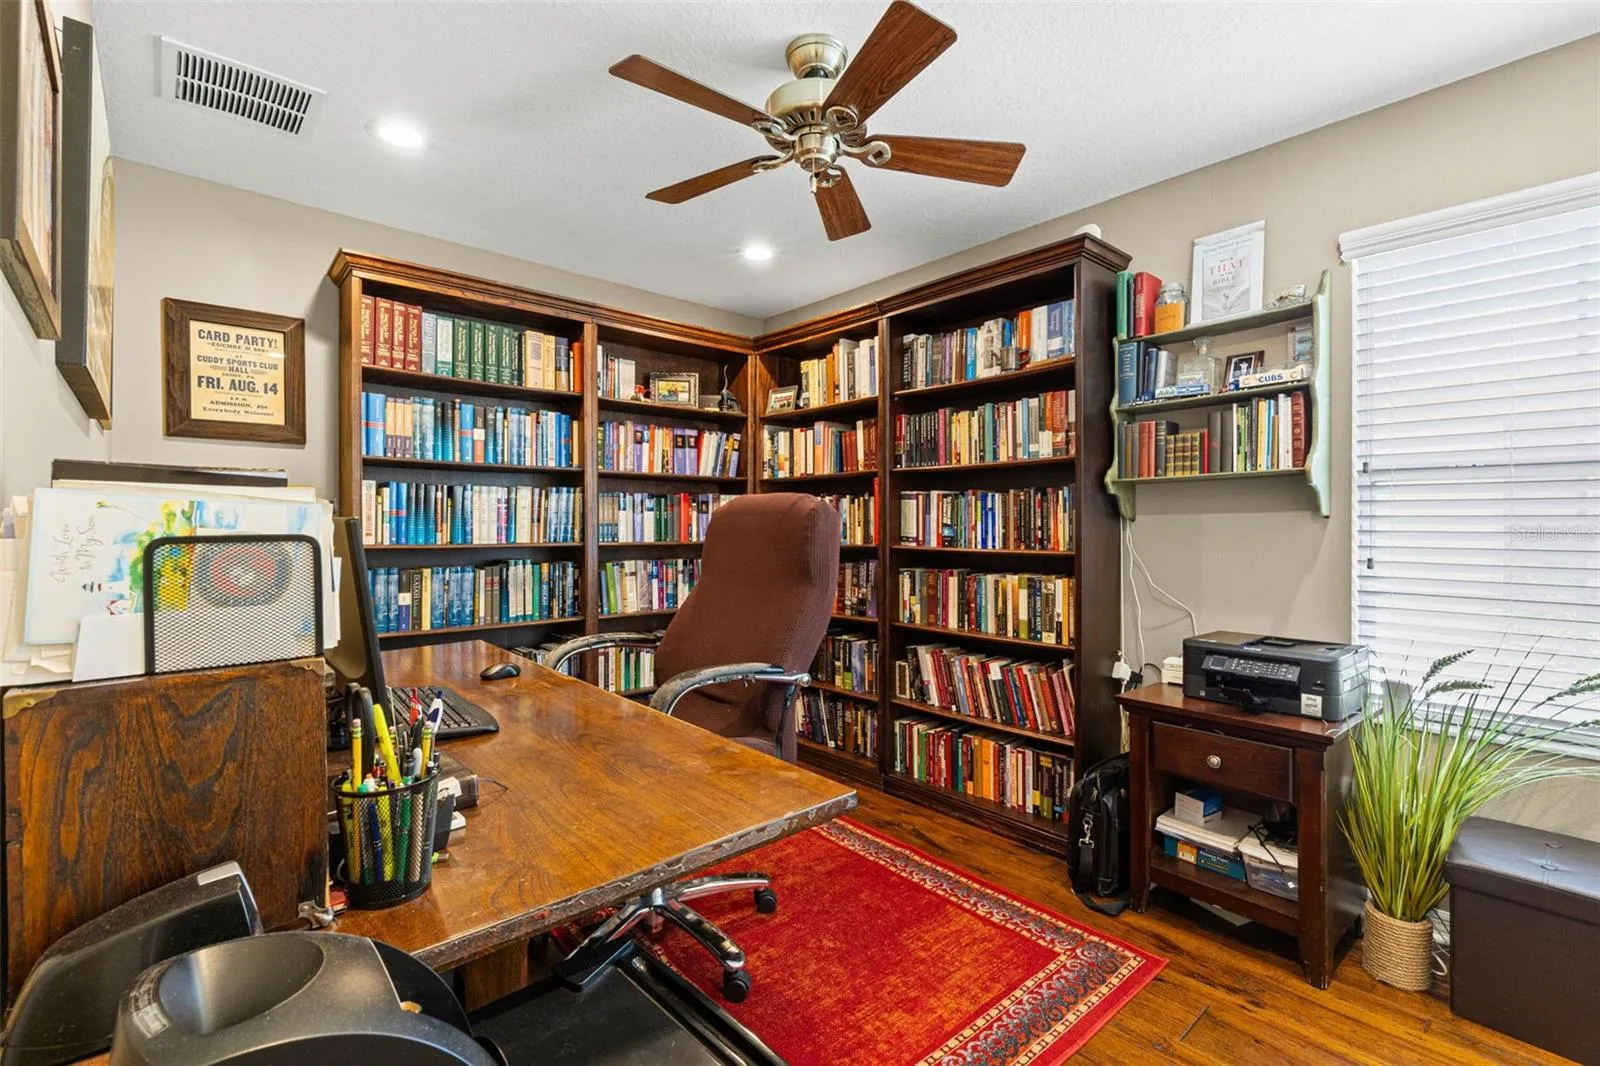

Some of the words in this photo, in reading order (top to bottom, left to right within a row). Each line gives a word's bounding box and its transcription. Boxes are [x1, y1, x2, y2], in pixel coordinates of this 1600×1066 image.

[197, 328, 231, 343] CARD
[235, 333, 278, 349] PARTY!
[196, 354, 225, 364] CUDDY
[226, 358, 258, 368] SPORTS
[258, 362, 279, 370] CLUB
[228, 365, 249, 374] HALL
[1258, 373, 1284, 383] CUBS
[197, 375, 225, 390] FRI.
[229, 378, 260, 394] AUG.
[263, 382, 279, 395] 14
[202, 406, 242, 415] Everybody
[209, 400, 253, 409] ADMISSION,
[413, 574, 422, 599] ISAIAH
